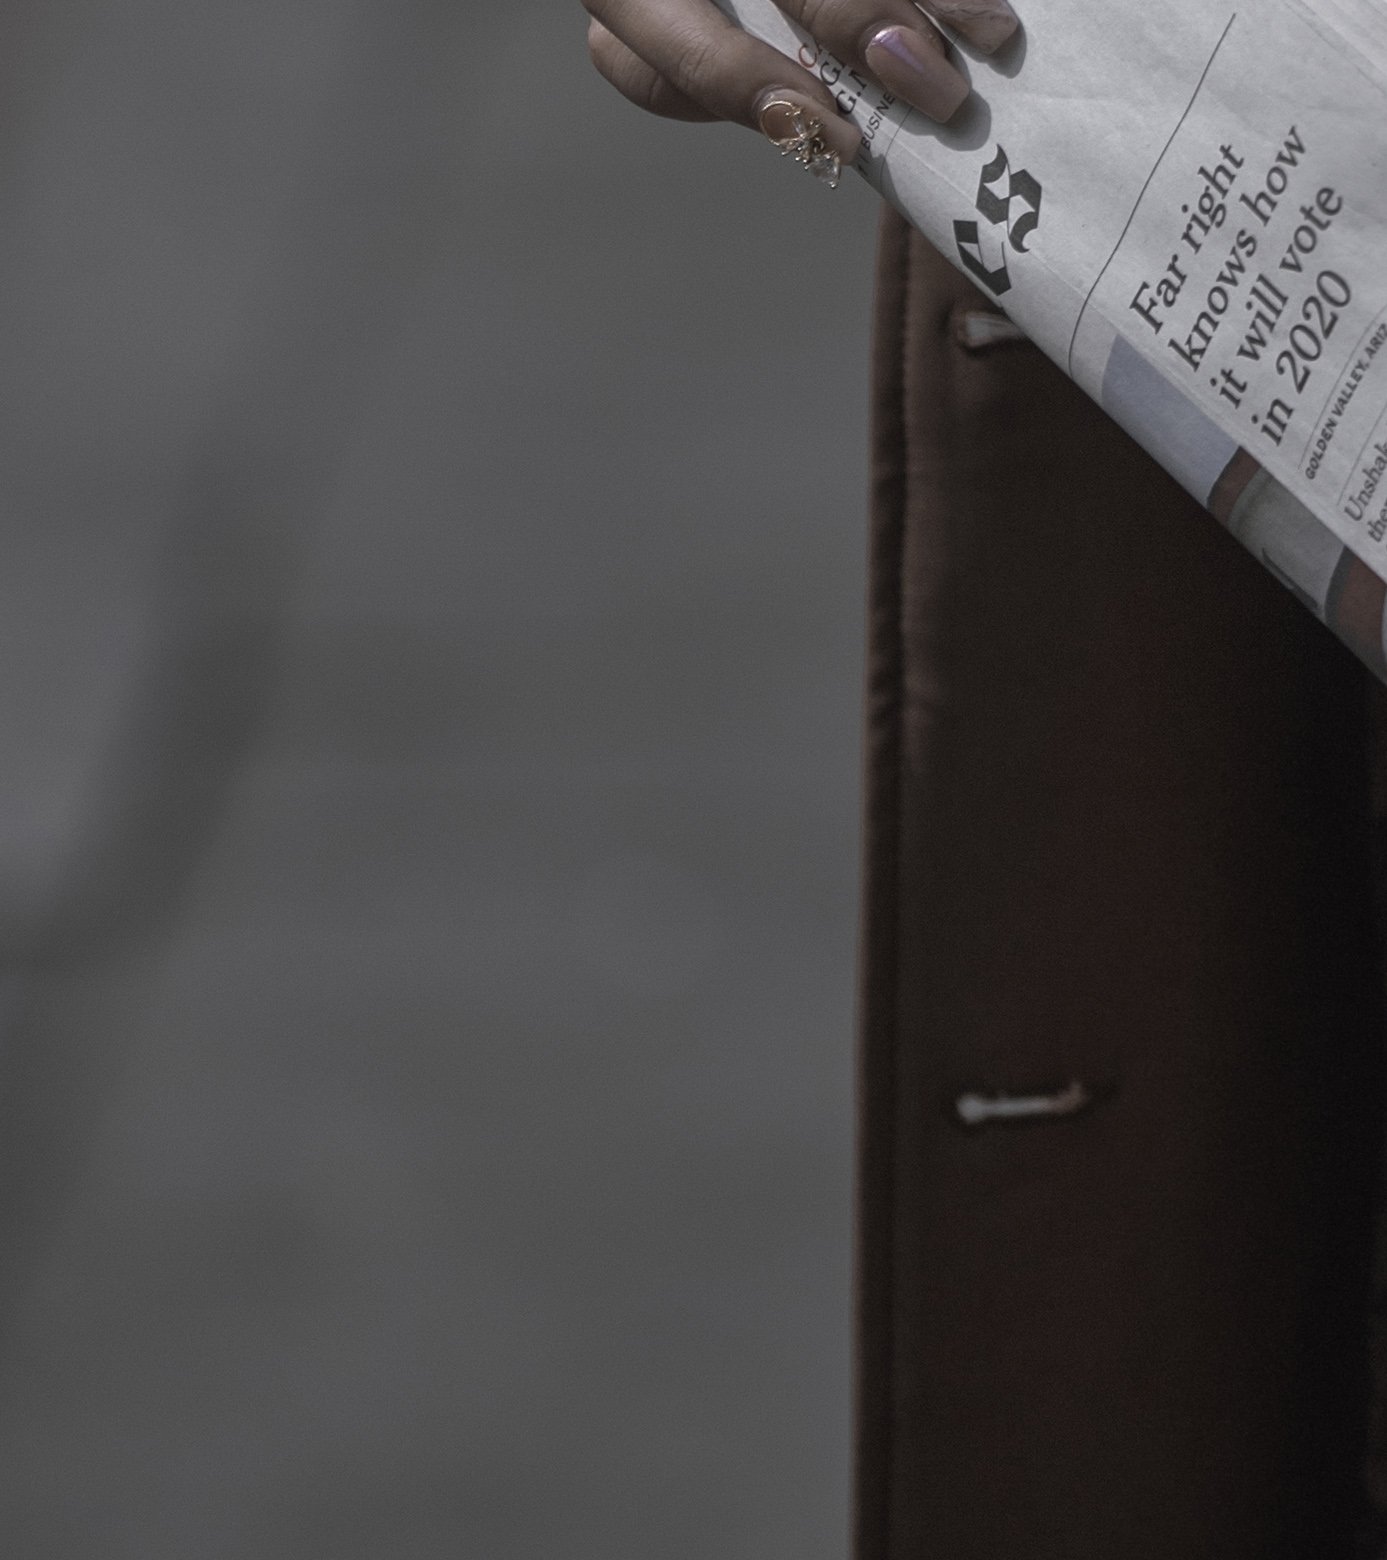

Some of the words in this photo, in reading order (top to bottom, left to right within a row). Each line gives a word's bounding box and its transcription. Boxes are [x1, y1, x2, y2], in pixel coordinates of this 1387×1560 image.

[1129, 253, 1187, 334] Far
[1180, 144, 1244, 254] right
[1167, 229, 1256, 371] knows
[1238, 125, 1305, 226] how
[1209, 368, 1247, 409] it
[1236, 273, 1288, 360] will
[1278, 186, 1342, 272] vote
[1251, 398, 1293, 446] in
[1275, 270, 1350, 393] 2020
[1305, 417, 1337, 479] GOLDEN
[1331, 359, 1369, 416] VALLEY,
